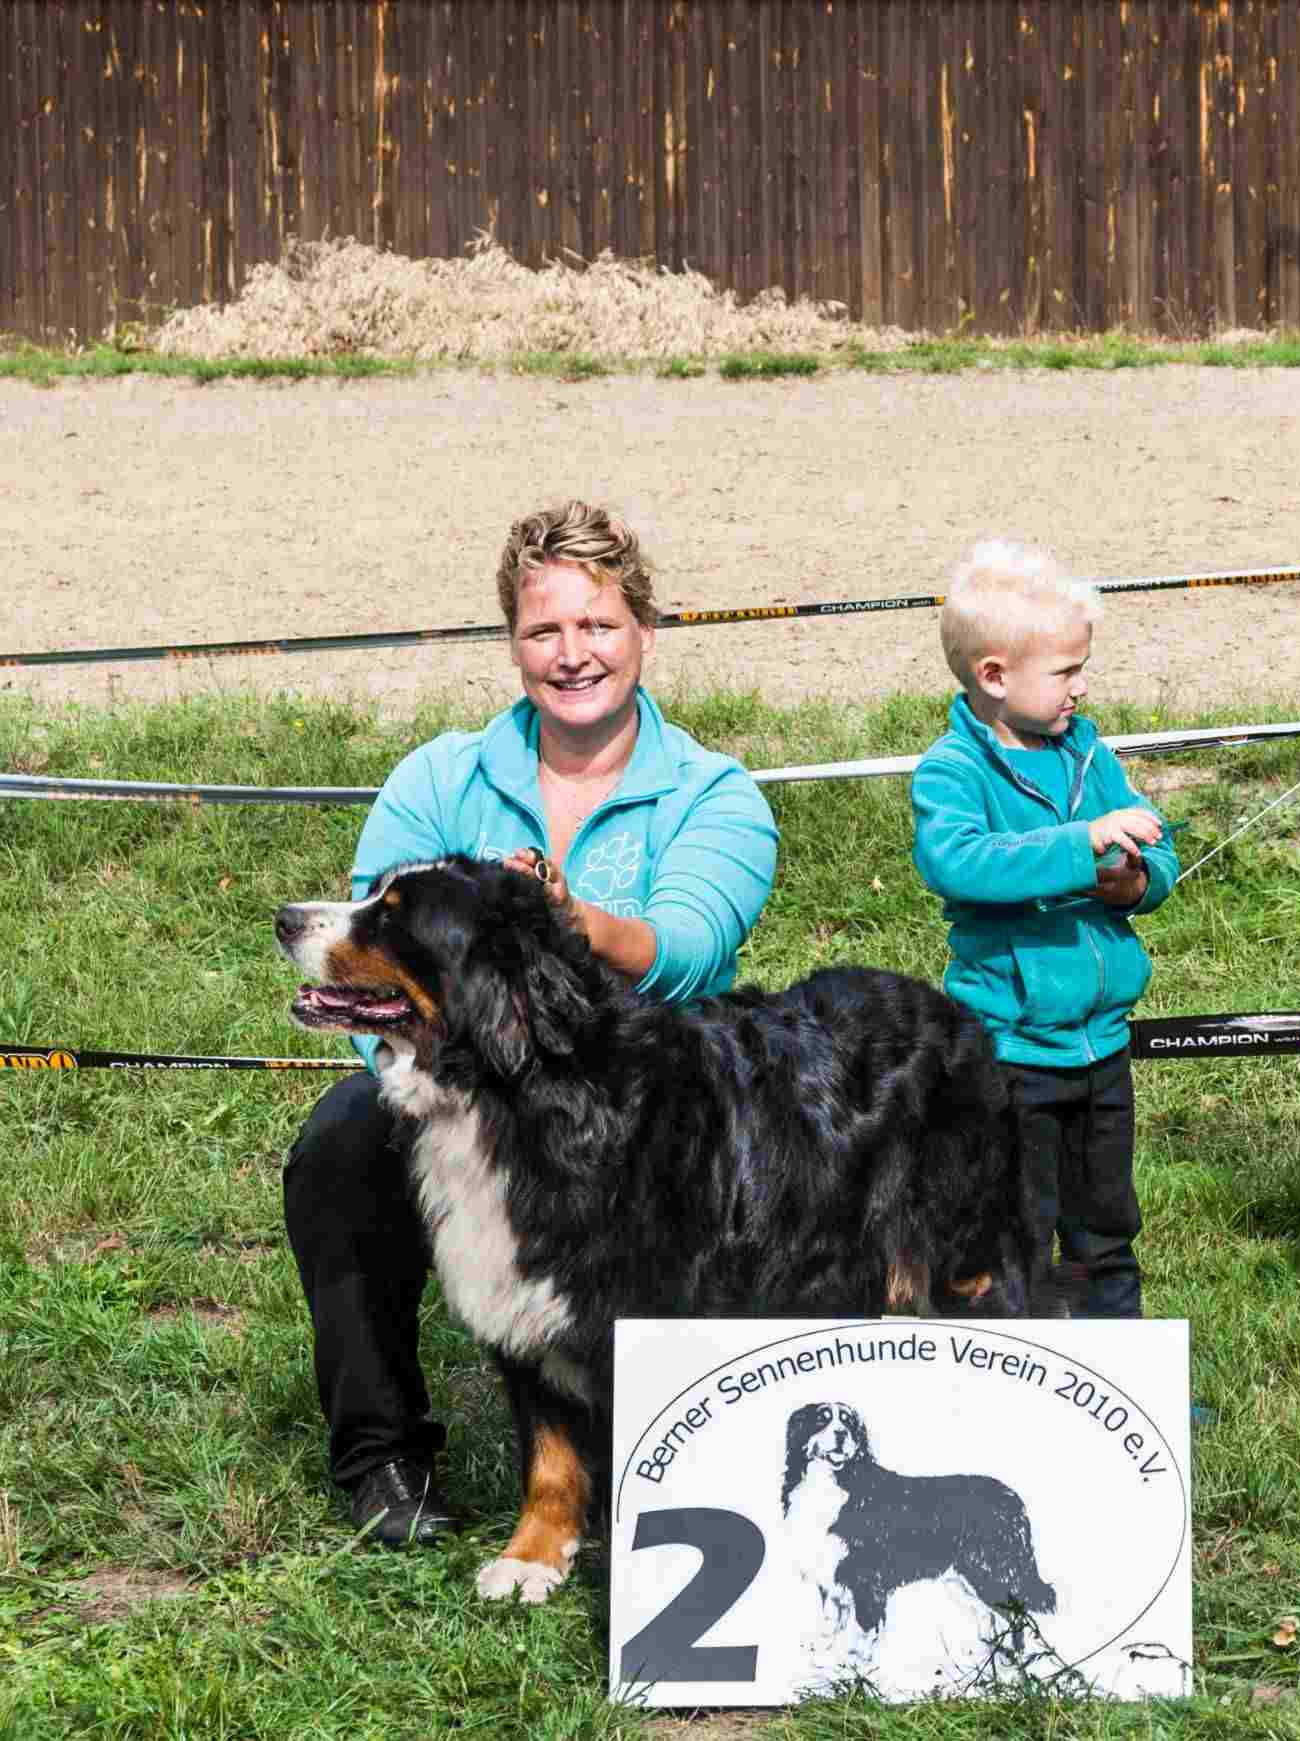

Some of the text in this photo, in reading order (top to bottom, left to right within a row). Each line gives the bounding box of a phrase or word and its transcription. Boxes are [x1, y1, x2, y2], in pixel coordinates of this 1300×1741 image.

[819, 599, 909, 614] CHAMPION
[1150, 1032, 1269, 1049] CHAMPION
[635, 1333, 1167, 1484] Berner Sennenhunde Verein 2010 e.V.
[620, 1507, 766, 1682] 2
